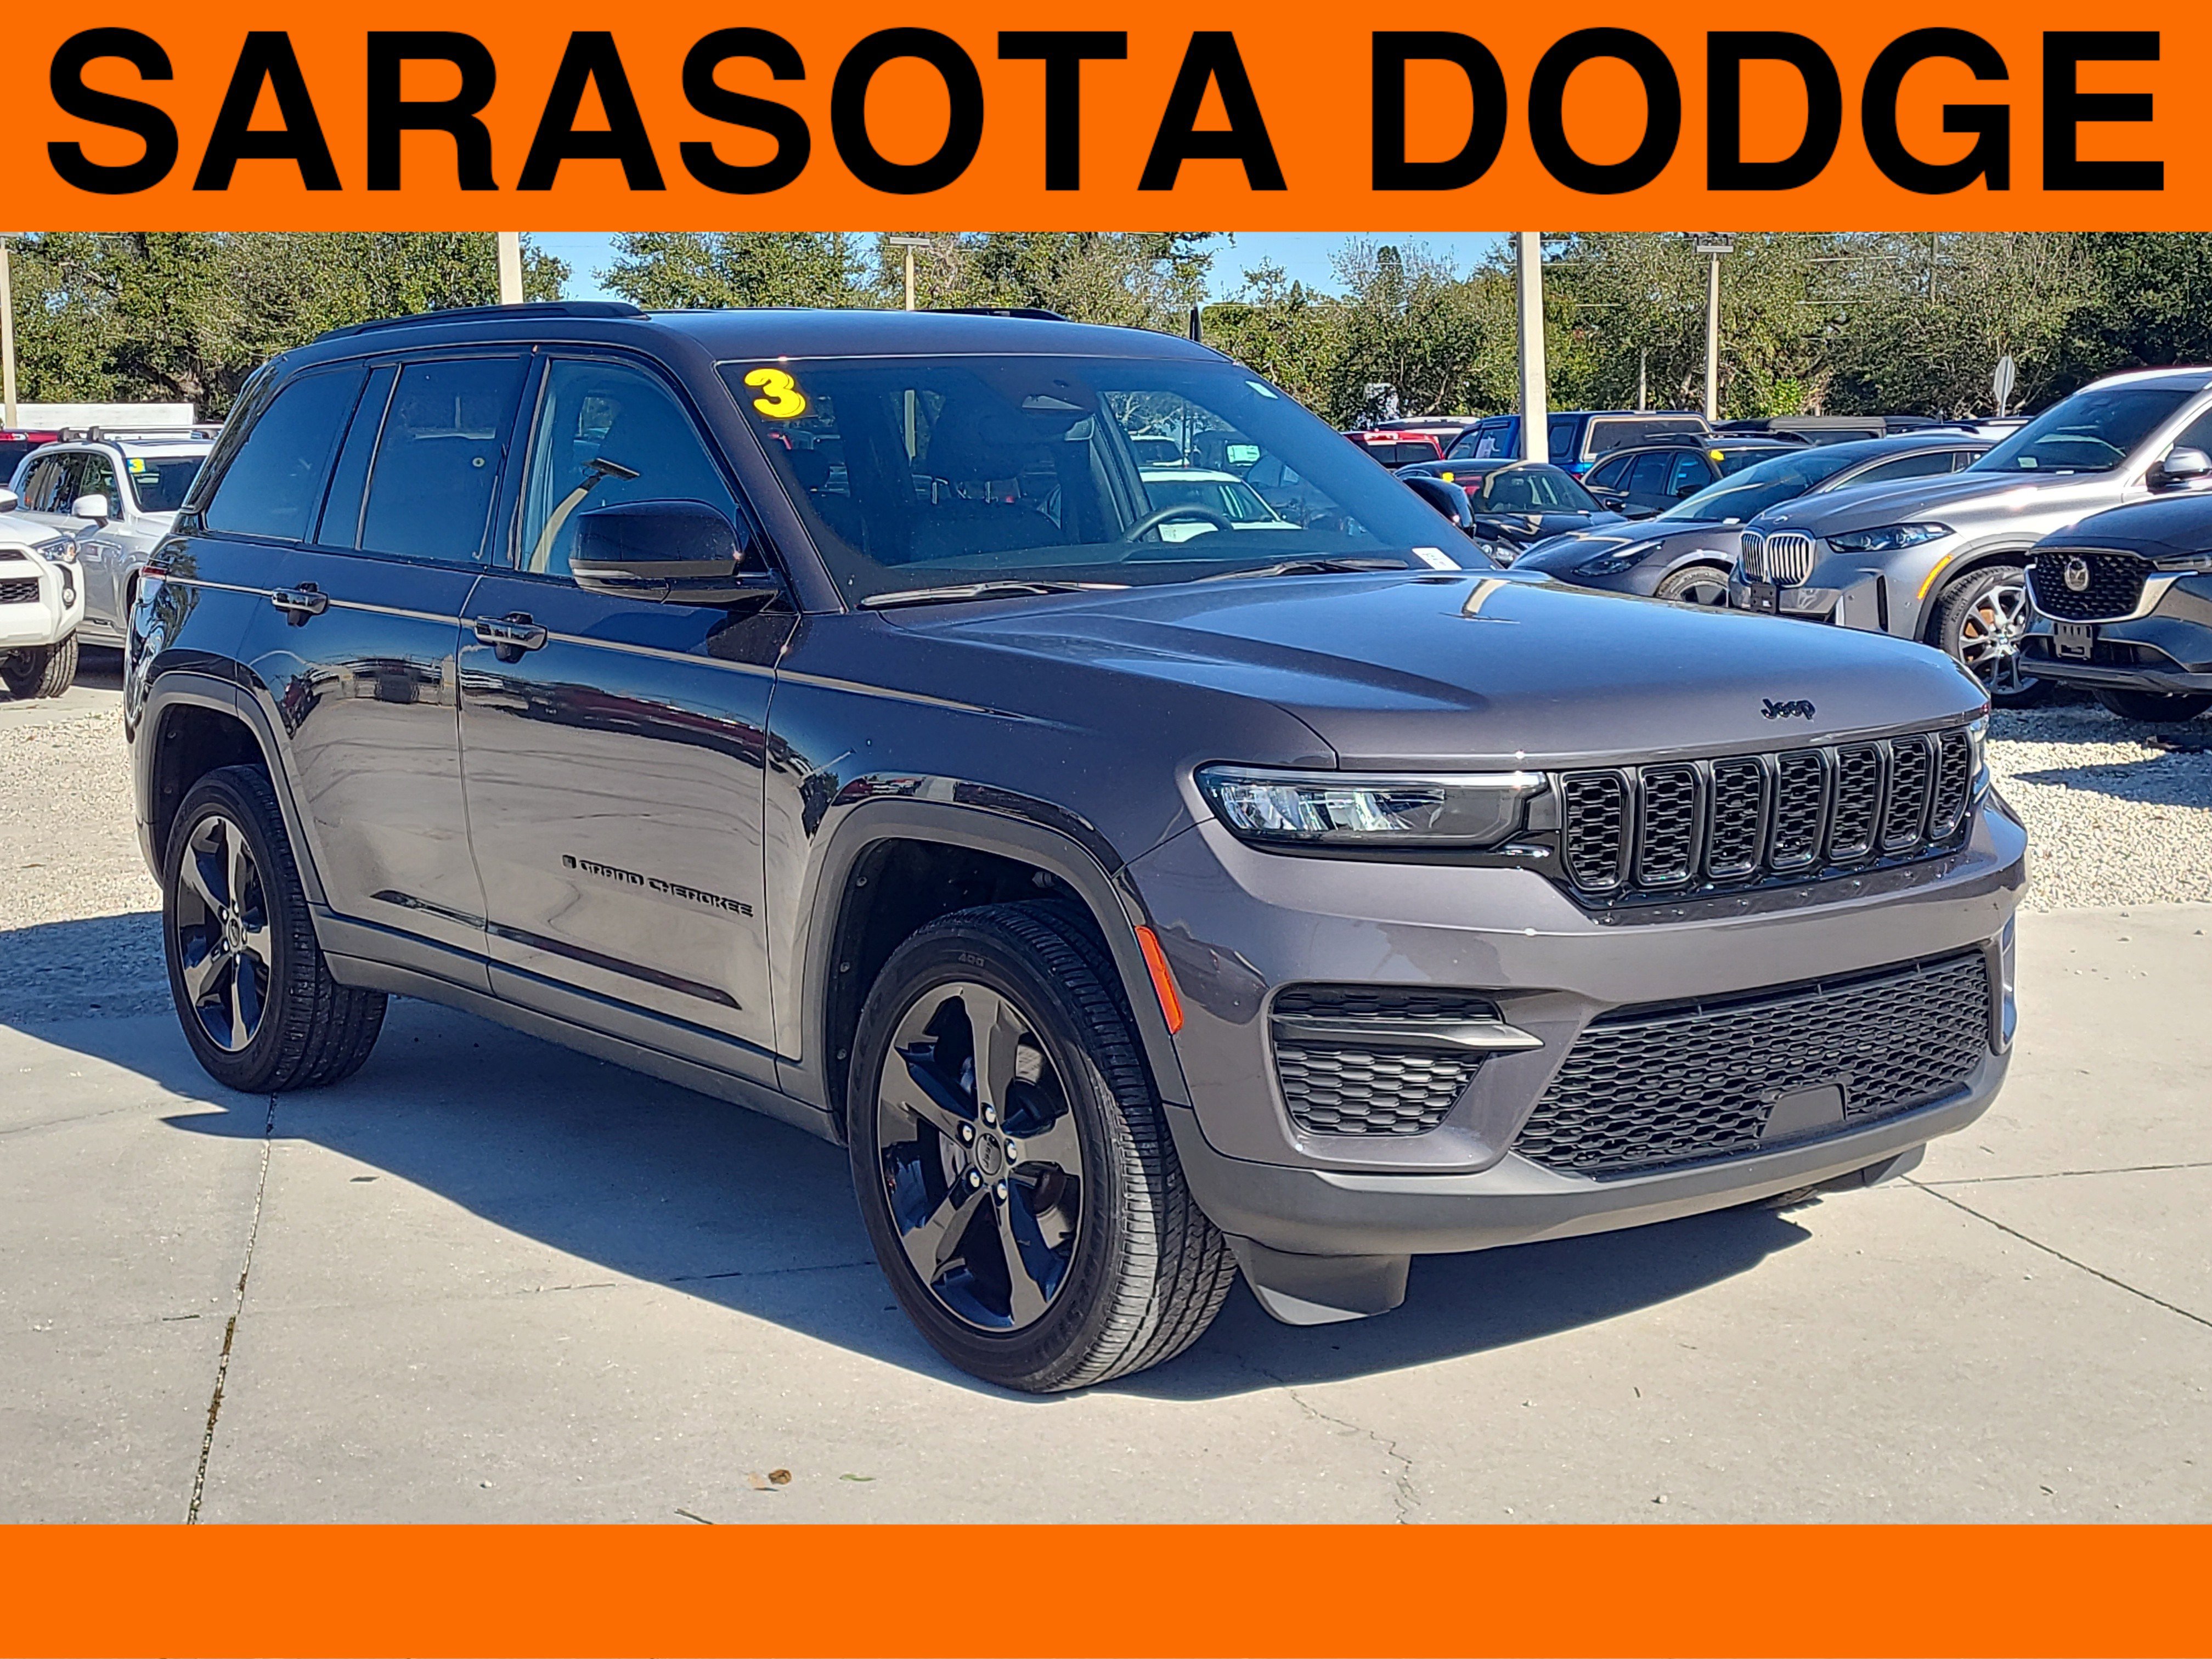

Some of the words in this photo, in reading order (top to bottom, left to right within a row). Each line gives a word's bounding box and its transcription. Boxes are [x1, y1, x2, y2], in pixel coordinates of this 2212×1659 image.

[744, 368, 806, 418] 3
[1760, 698, 1816, 720] Jeep
[579, 859, 644, 885] GRAND
[647, 878, 754, 917] CHEROKEE
